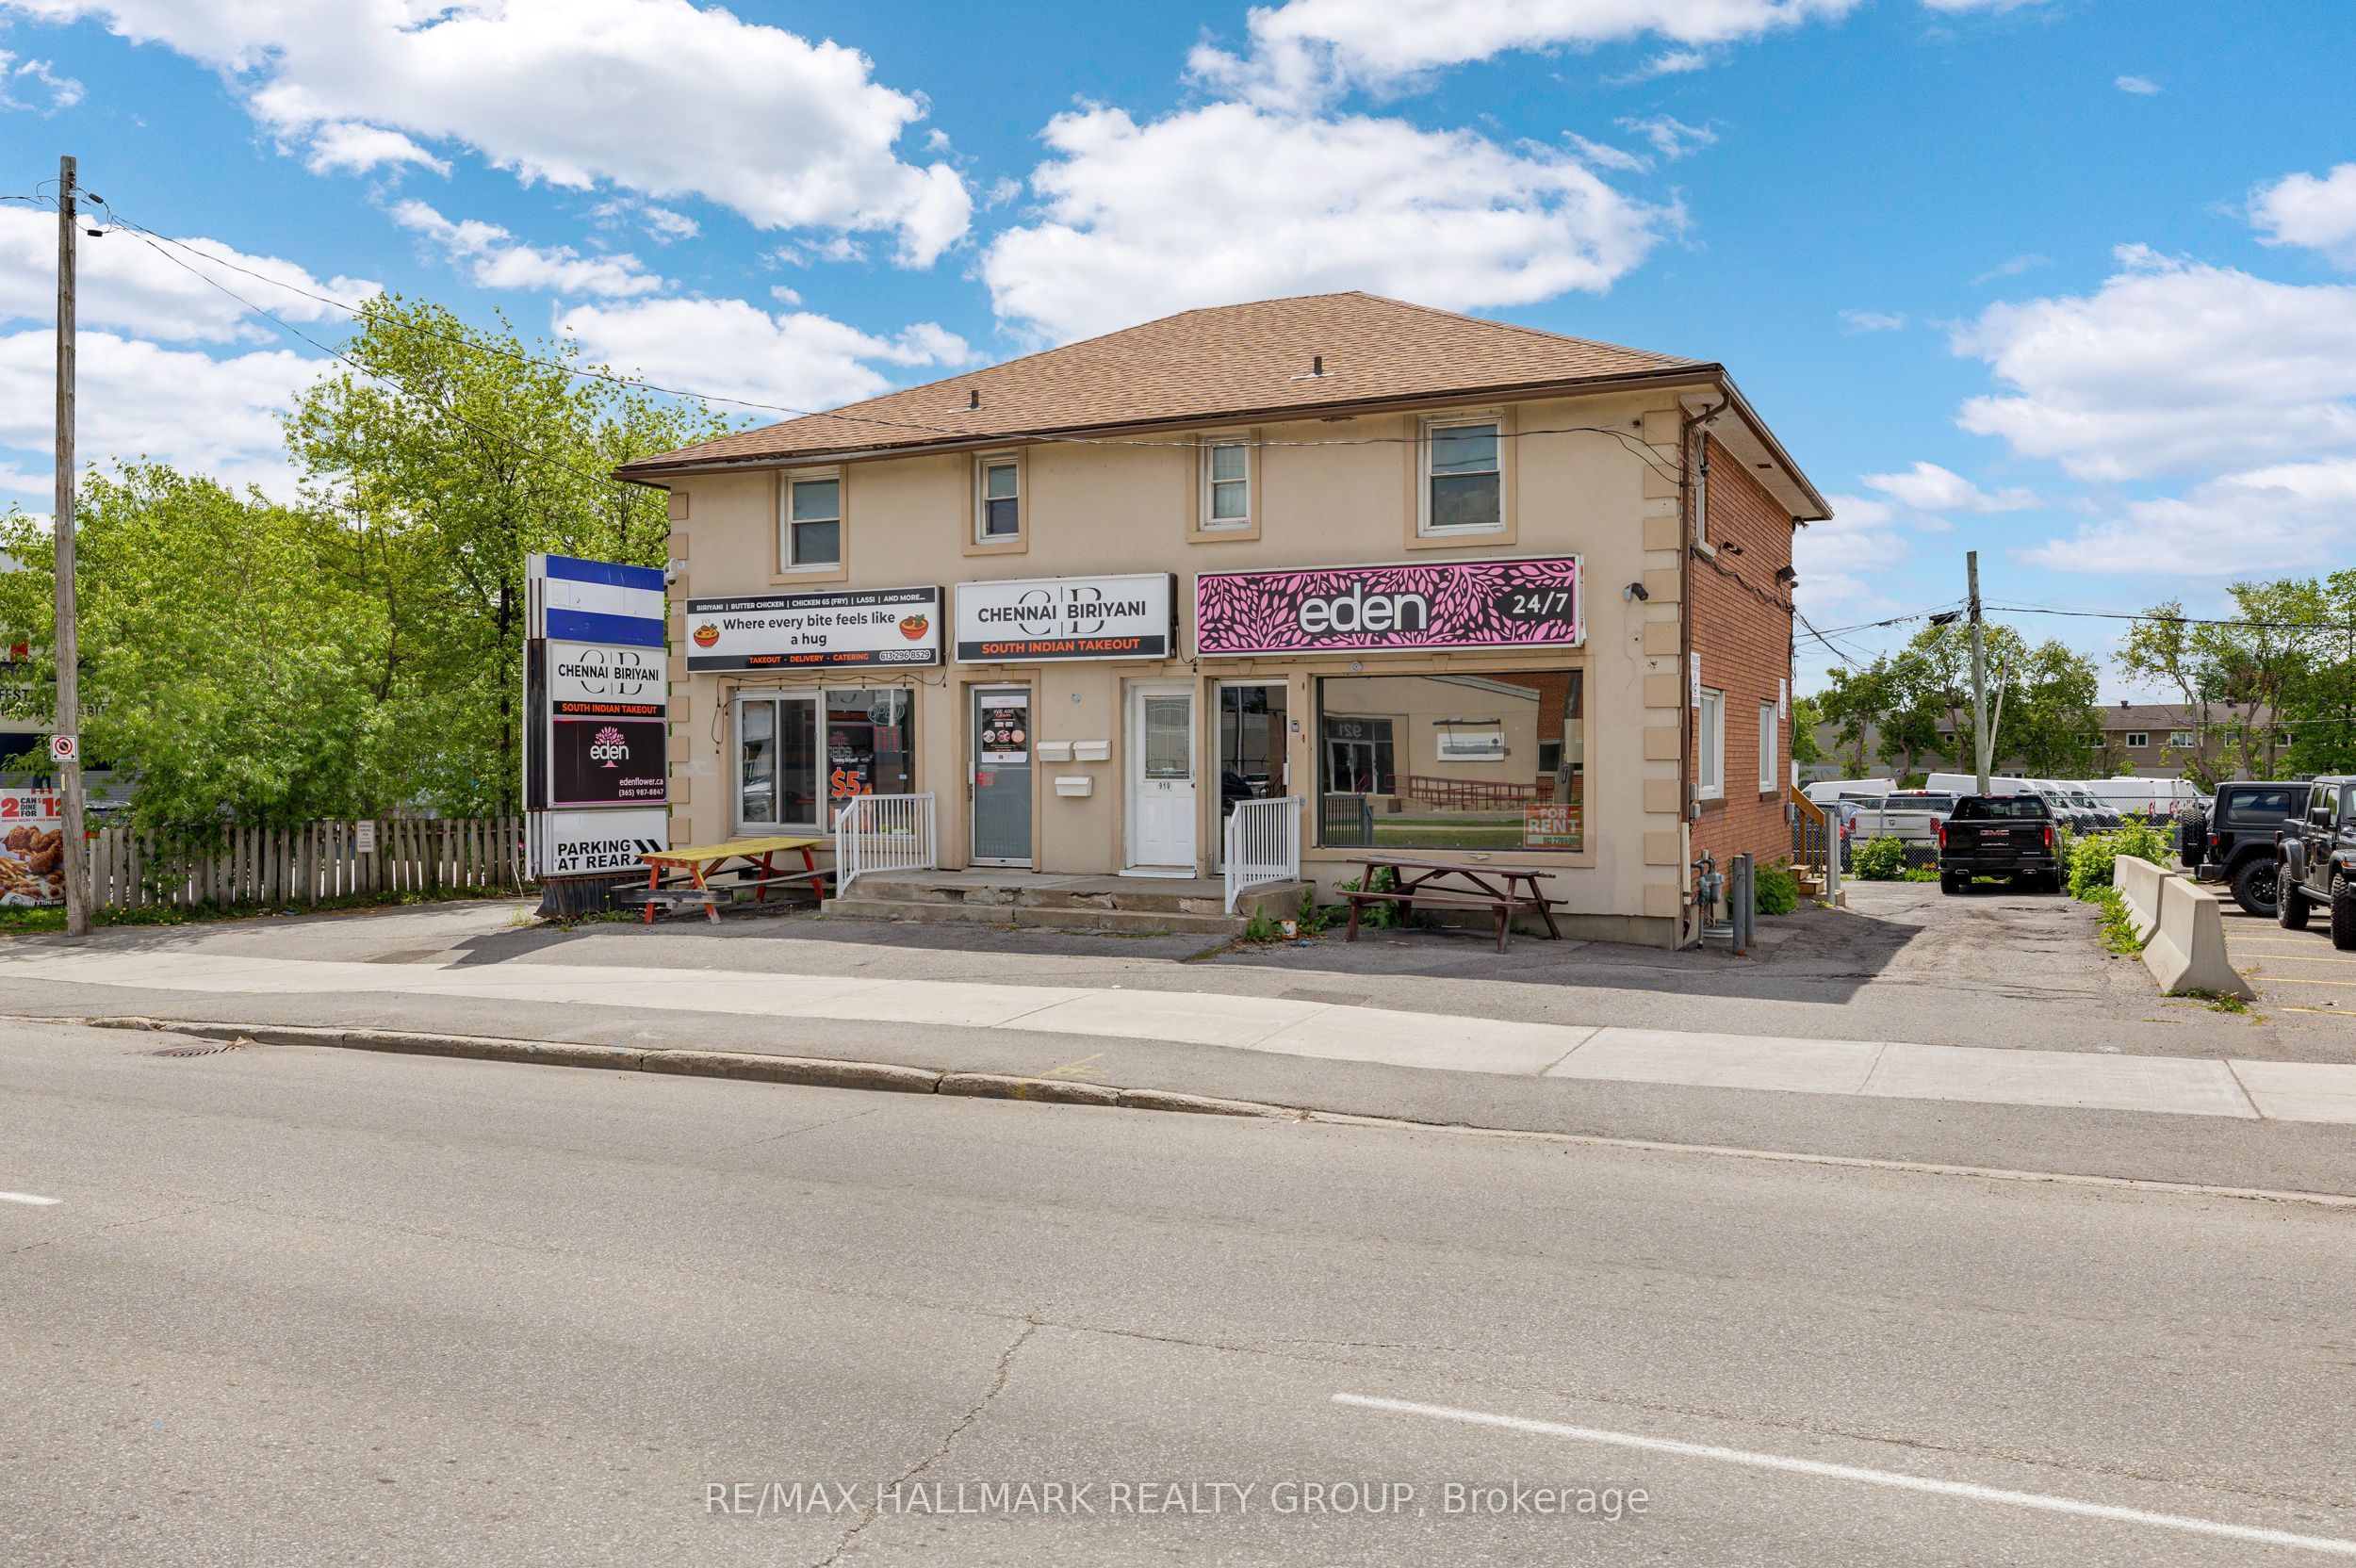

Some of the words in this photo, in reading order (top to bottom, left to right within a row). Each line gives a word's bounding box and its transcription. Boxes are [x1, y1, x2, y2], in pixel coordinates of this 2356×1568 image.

[831, 597, 848, 606] (FRY)
[857, 596, 875, 604] LASSI
[1299, 582, 1427, 633] eden
[1513, 592, 1568, 615] 24/7
[978, 605, 1056, 623] CHENNAI
[1068, 601, 1145, 619] BIRIYANI
[723, 614, 765, 630] Where
[769, 615, 803, 629] every
[808, 612, 831, 627] bite
[836, 612, 867, 626] feels
[872, 612, 895, 624] like
[791, 635, 798, 645] a
[802, 633, 826, 647] hug
[982, 643, 1025, 654] SOUTH
[1029, 641, 1074, 653] INDIAN
[1078, 639, 1139, 651] TAKEOUT
[749, 656, 780, 664] TAKEOUT
[790, 655, 824, 663] DELIVERY
[894, 651, 909, 660] 296
[910, 650, 930, 660] 8529
[558, 663, 608, 678] CHENNAI
[614, 668, 659, 681] BIRIYANI
[562, 703, 590, 712] SOUTH
[592, 705, 620, 713] INDIAN
[622, 706, 657, 714] TAKEOUT
[590, 741, 629, 760] eden
[619, 777, 663, 786] edenflower.ca
[831, 767, 860, 800] $5
[2, 797, 19, 817] 2
[1540, 808, 1566, 818] FOR
[1529, 819, 1579, 833] RENT
[558, 840, 630, 856] PARKING
[558, 858, 579, 871] AT
[586, 854, 630, 869] REAR
